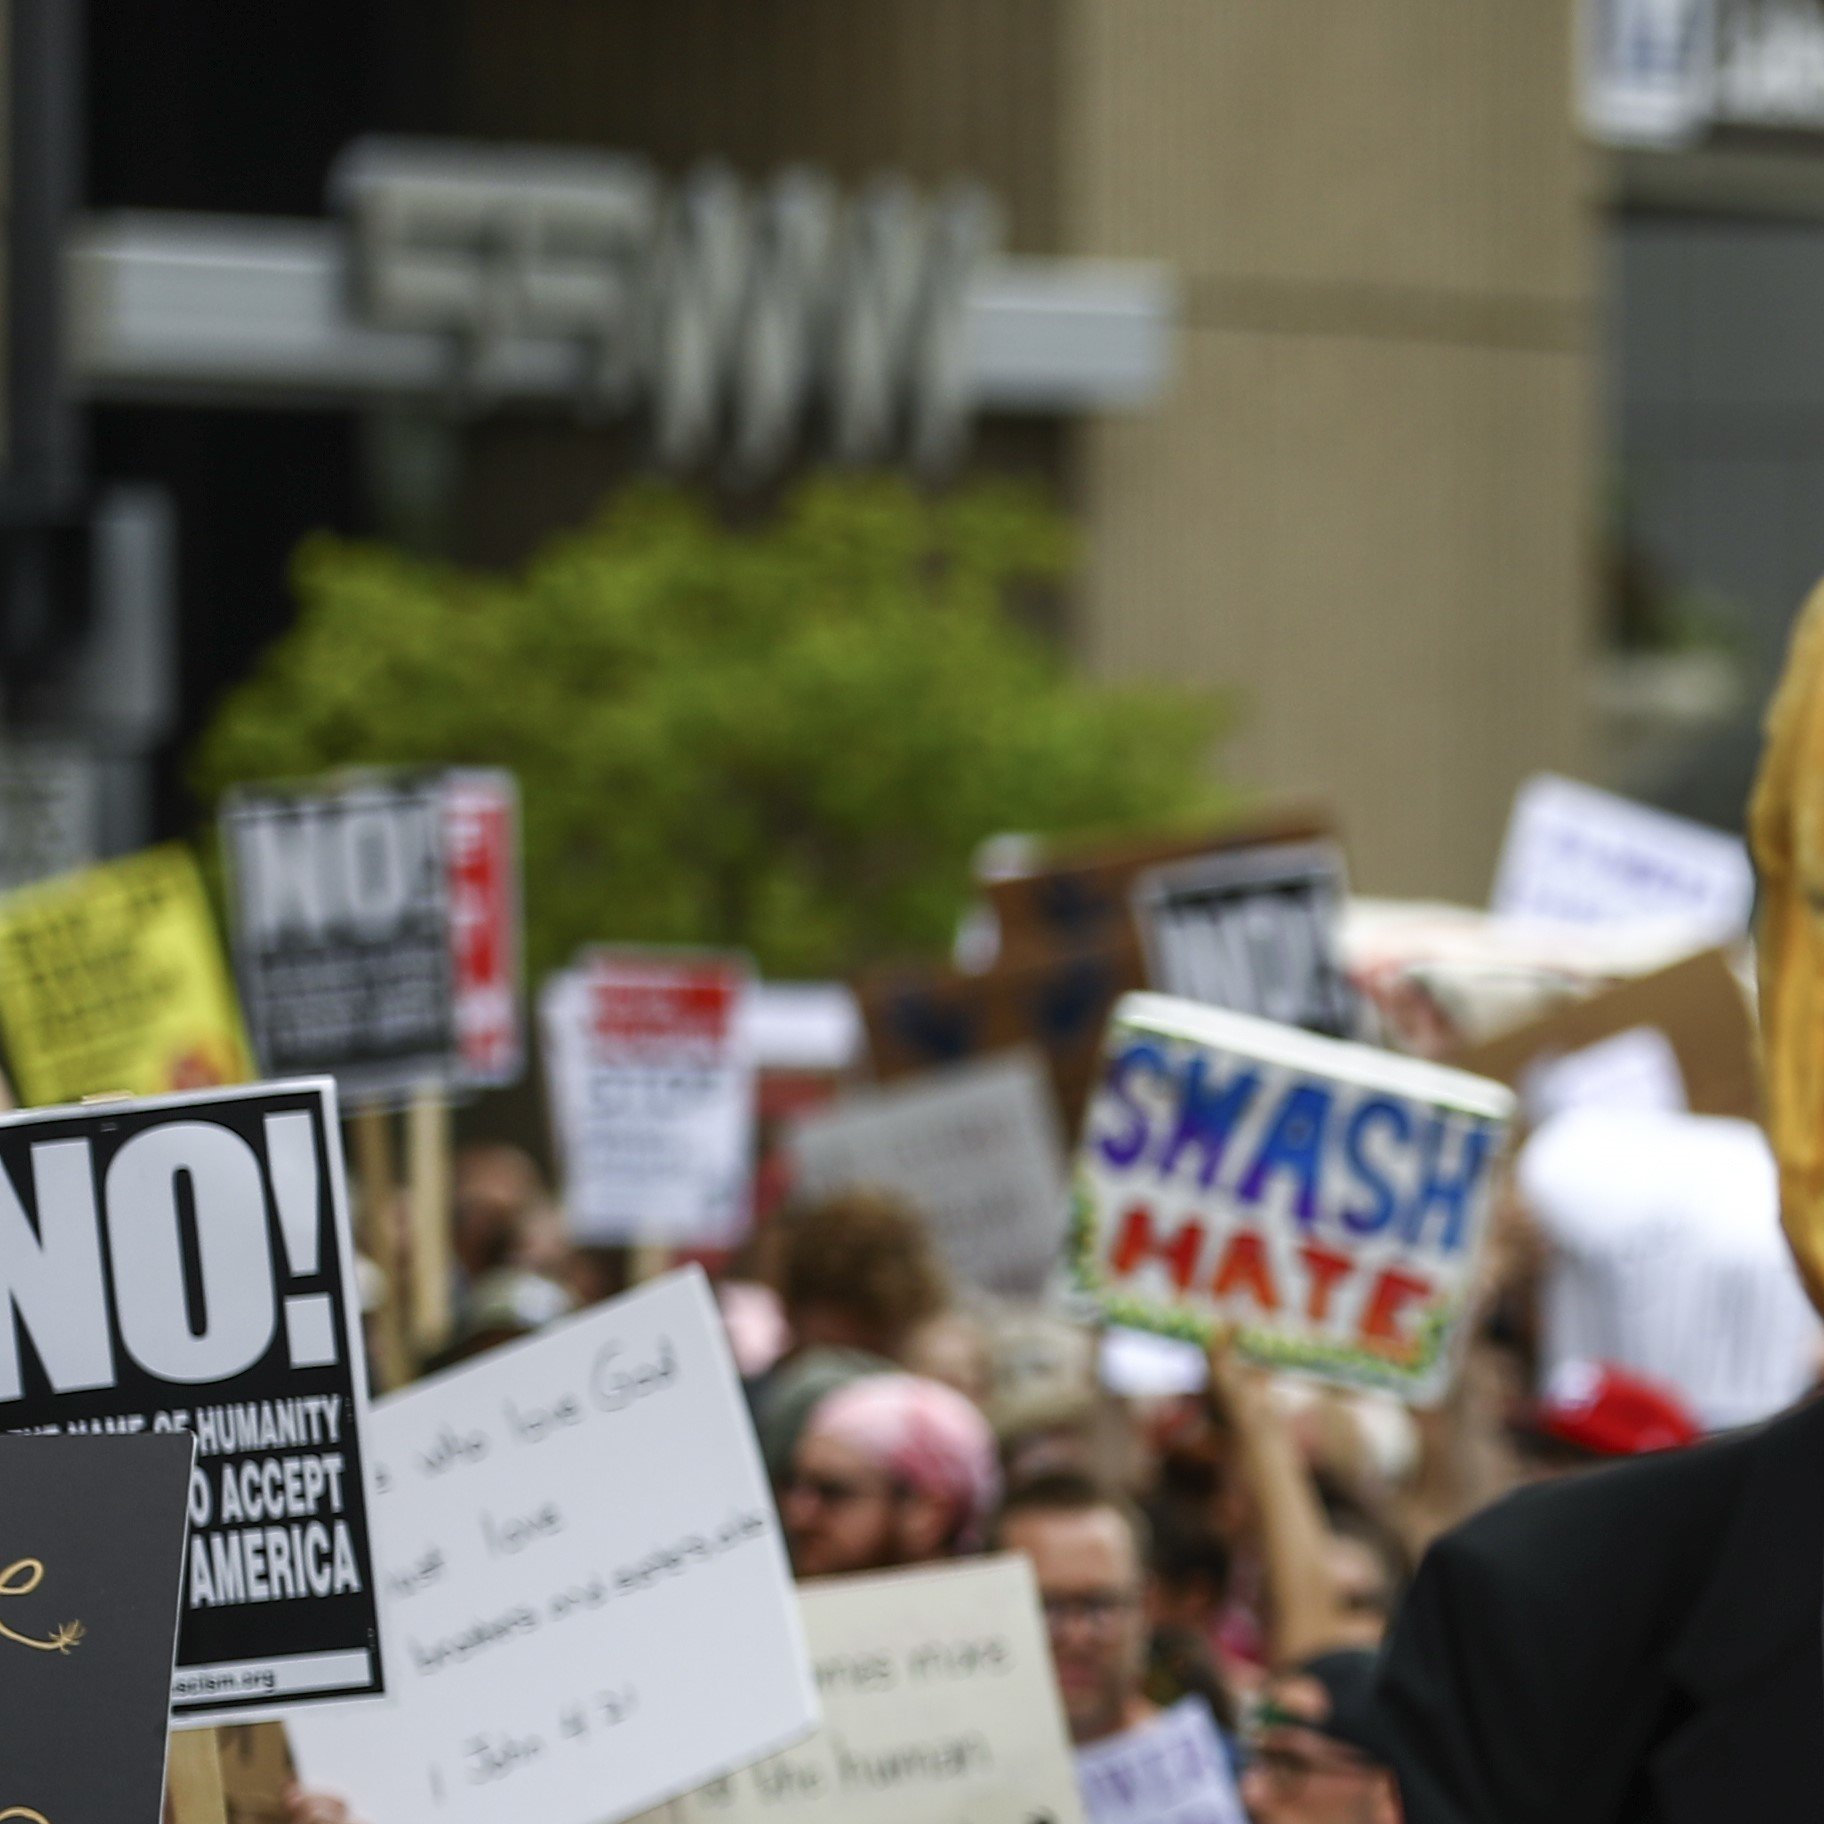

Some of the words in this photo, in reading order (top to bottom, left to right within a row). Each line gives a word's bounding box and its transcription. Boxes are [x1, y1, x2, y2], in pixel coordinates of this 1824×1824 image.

[1098, 1042, 1494, 1255] SMASH
[1109, 1204, 1433, 1363] HATE
[195, 1393, 343, 1456] HUMANITY
[221, 1452, 345, 1525] ACCEPT
[188, 1519, 363, 1610] AMERICA
